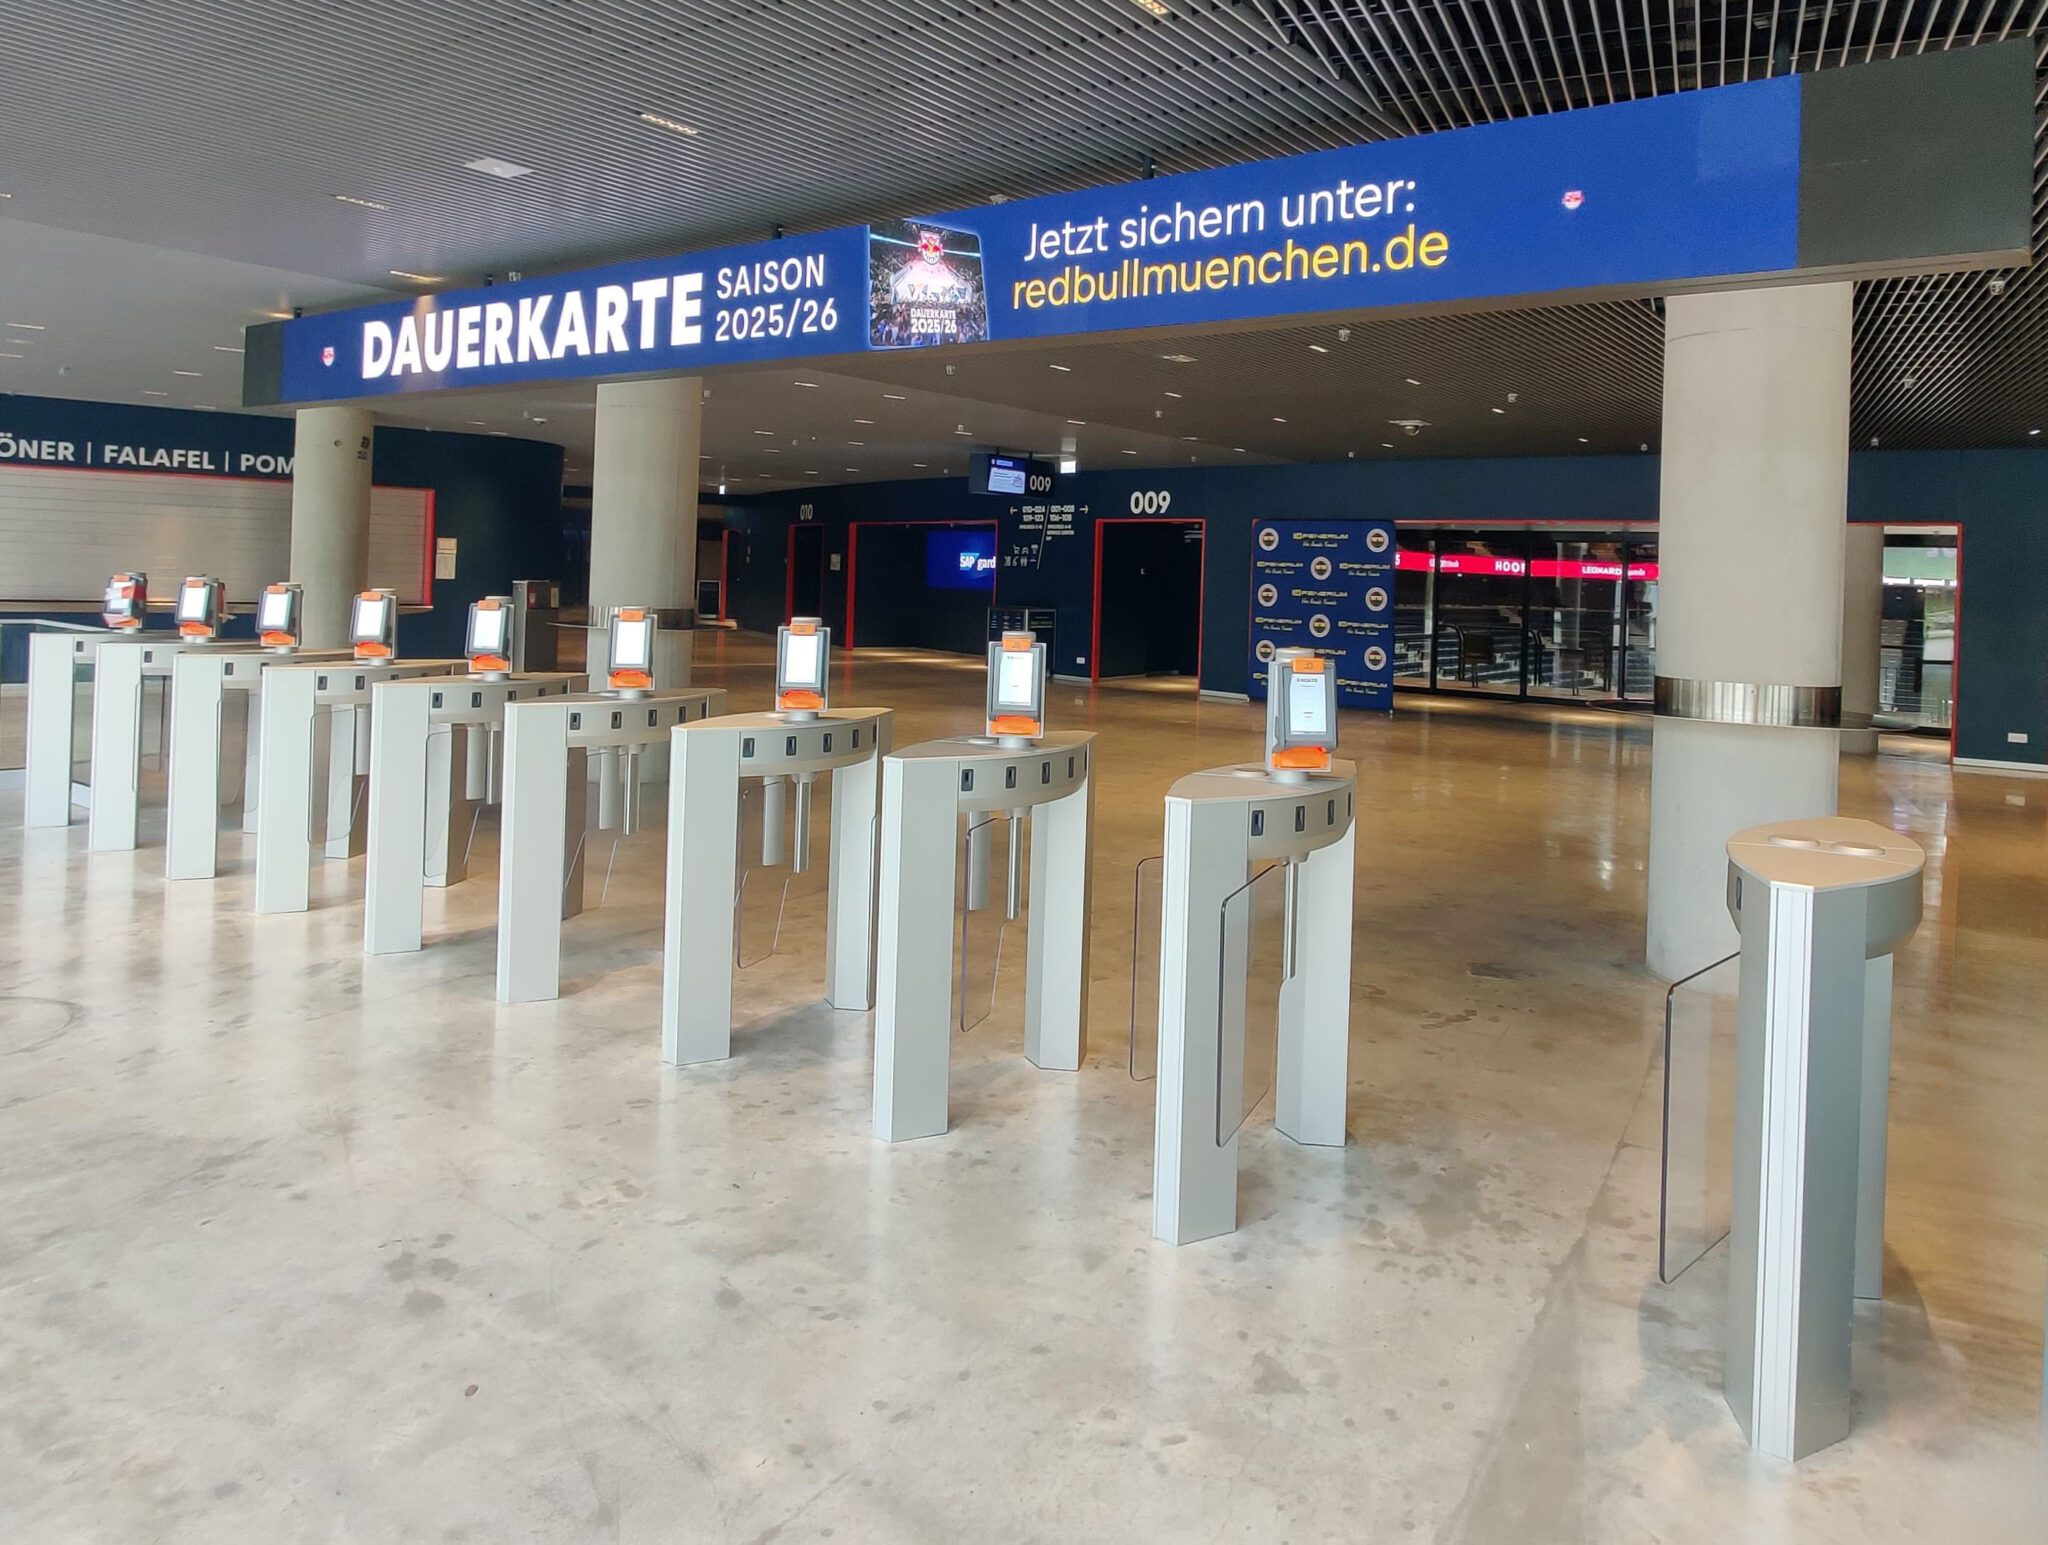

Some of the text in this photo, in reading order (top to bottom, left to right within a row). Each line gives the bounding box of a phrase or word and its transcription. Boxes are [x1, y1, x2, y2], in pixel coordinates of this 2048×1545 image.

[1023, 180, 1416, 261] Jetzt sichern unter:
[716, 254, 824, 299] SAISON
[1012, 223, 1449, 310] redbullmuenchen.de
[361, 271, 704, 380] DAUERKARTE
[714, 297, 838, 342] 2025/26
[910, 319, 957, 334] 2025/26
[104, 444, 215, 470] FALAFEL
[1029, 475, 1052, 492] 009
[800, 504, 814, 521] 010
[1130, 490, 1171, 514] 009
[960, 555, 975, 568] SAP
